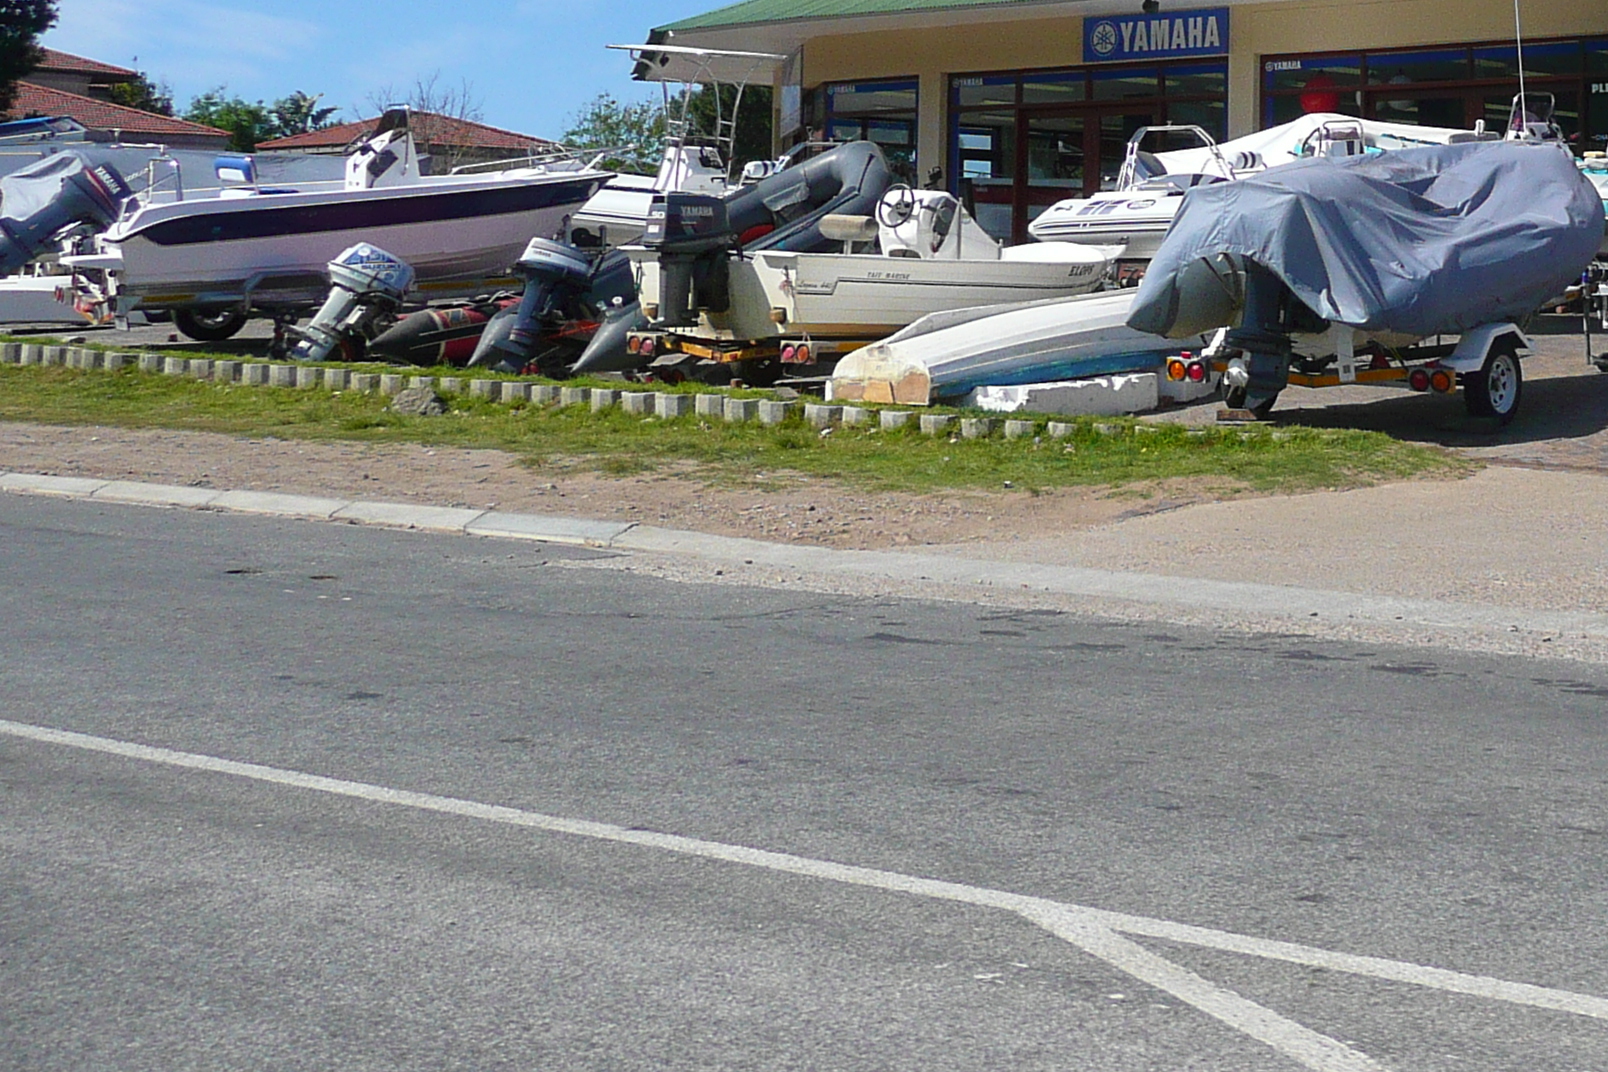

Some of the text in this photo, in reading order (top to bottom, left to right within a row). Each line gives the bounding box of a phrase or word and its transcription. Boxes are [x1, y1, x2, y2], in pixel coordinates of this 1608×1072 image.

[1120, 16, 1220, 52] YAMAHA
[1273, 60, 1301, 70] YAMAHA
[94, 166, 121, 194] YAMAHA
[681, 206, 714, 217] YAMAHA
